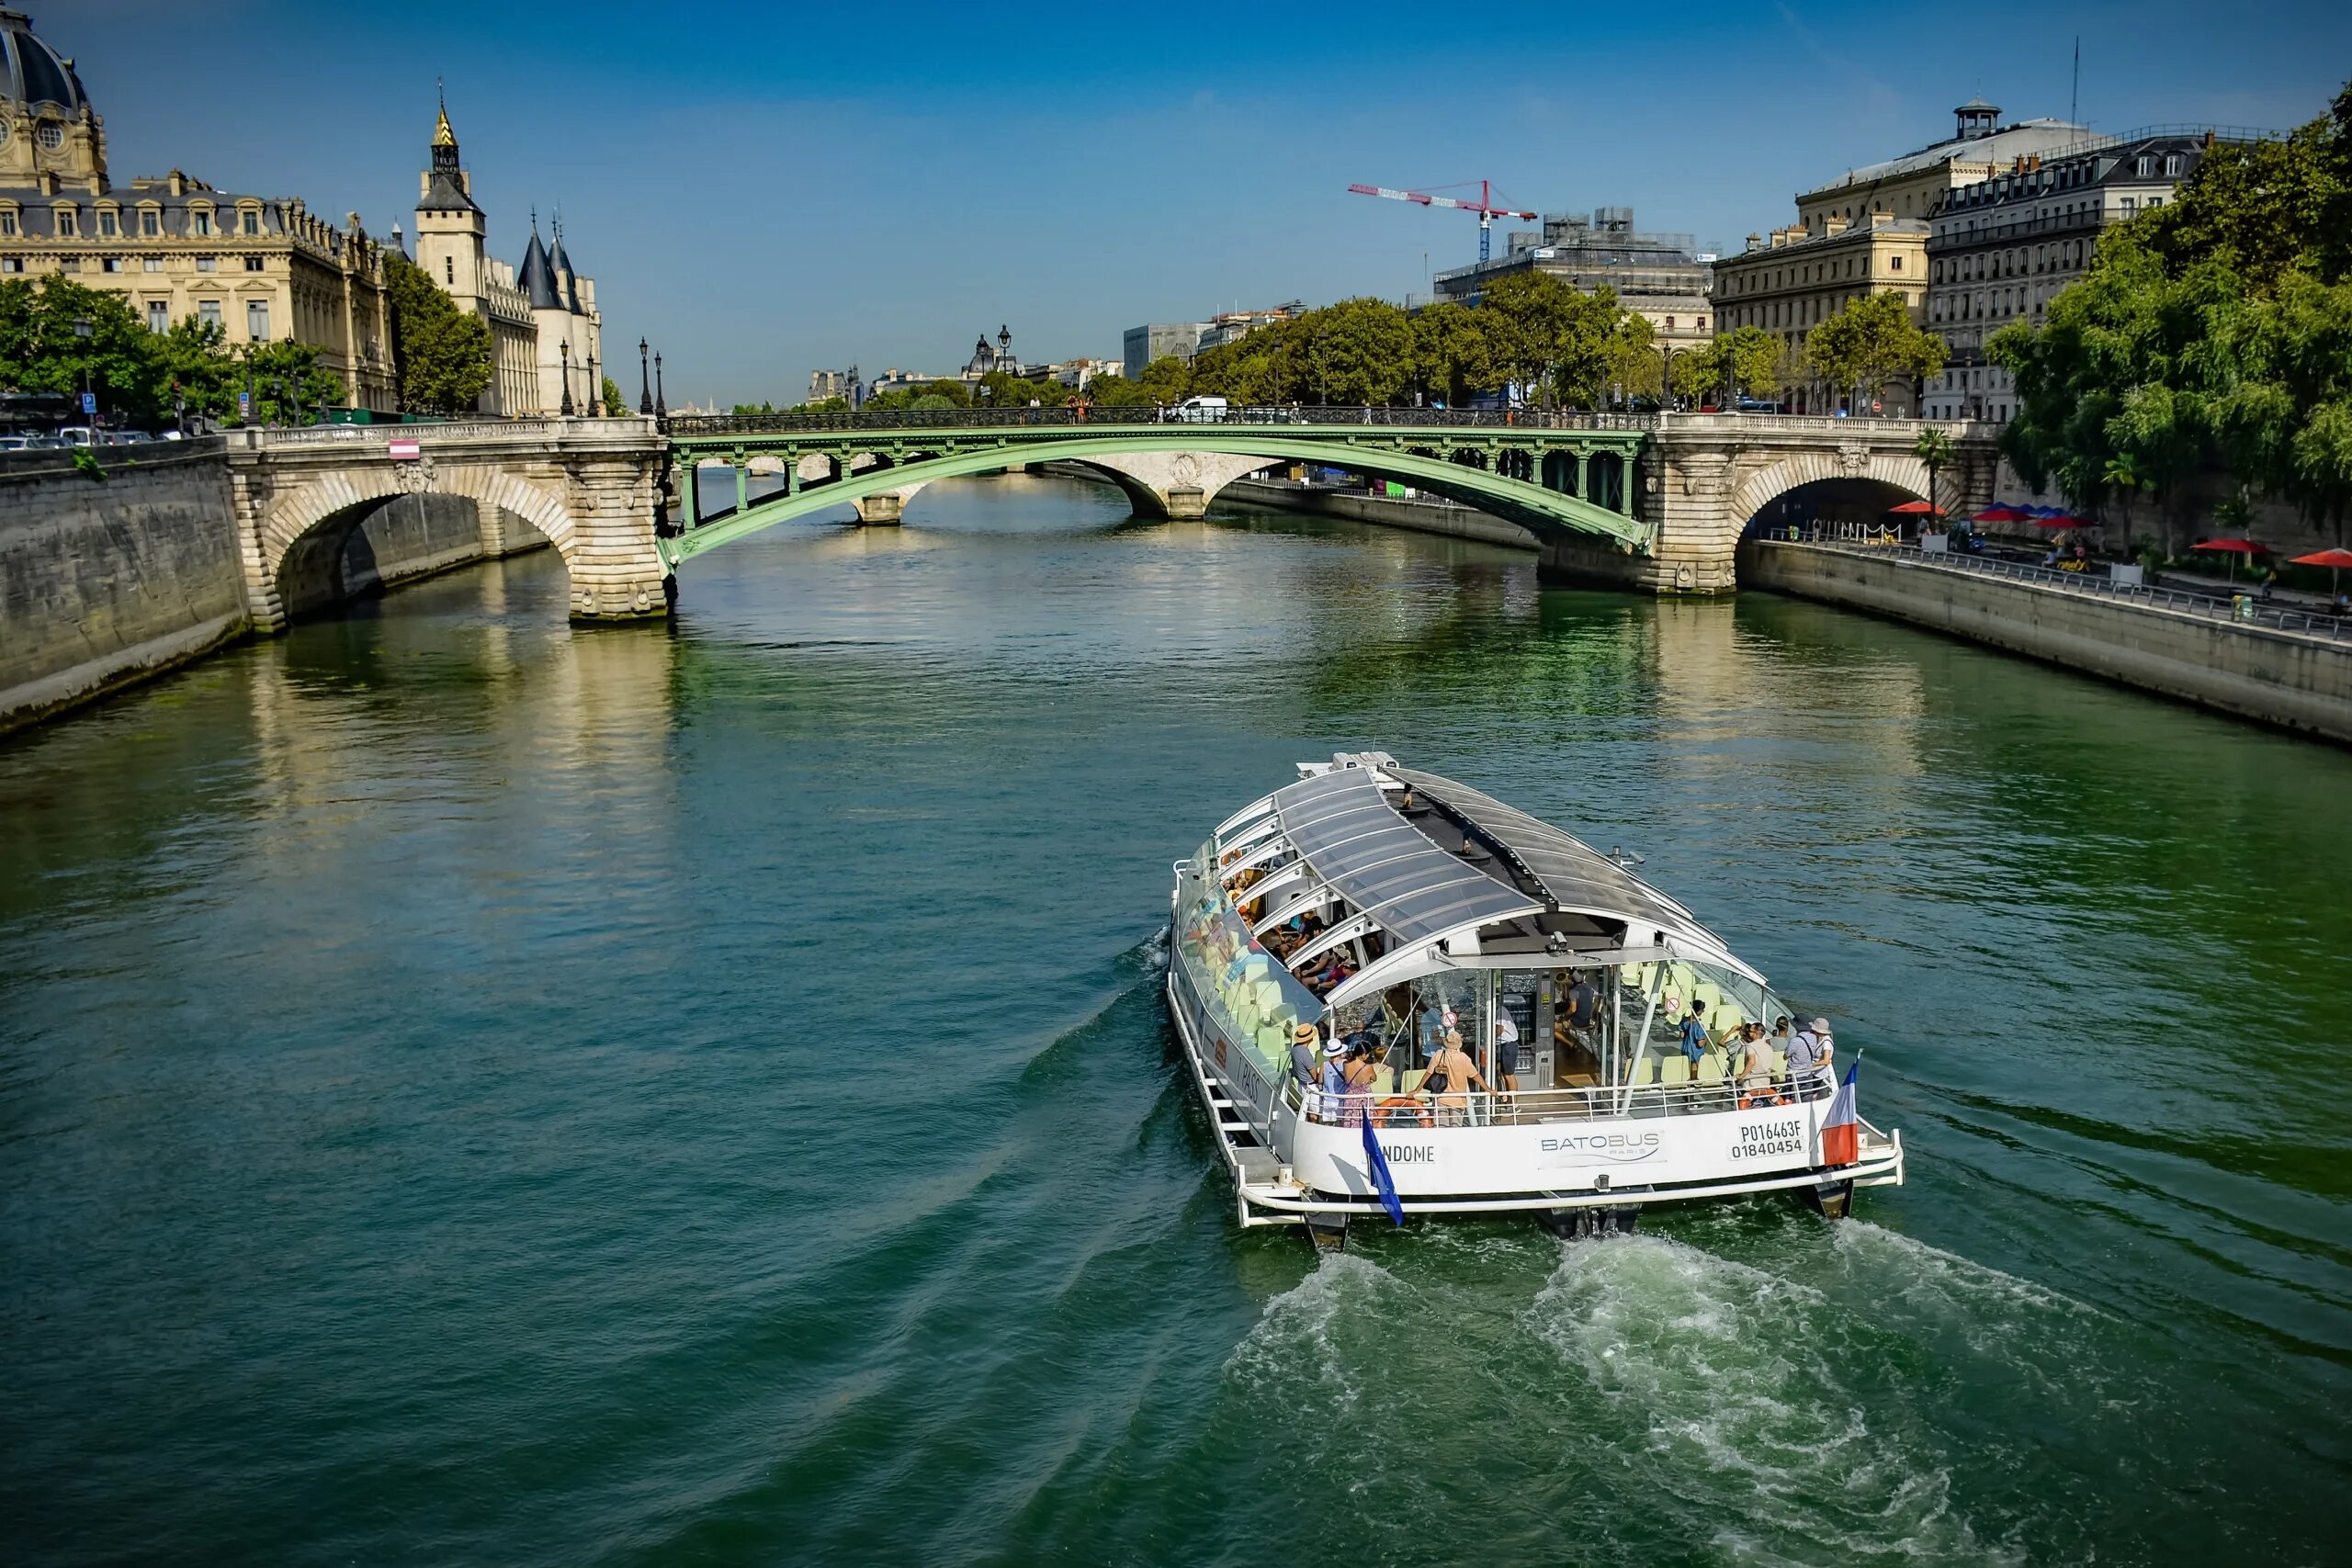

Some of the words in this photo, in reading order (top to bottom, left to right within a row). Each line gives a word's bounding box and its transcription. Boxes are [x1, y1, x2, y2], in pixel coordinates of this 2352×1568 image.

[85, 396, 92, 404] P
[1541, 1134, 1659, 1151] BATOBUS
[1732, 1140, 1802, 1158] 01840454
[1379, 1145, 1434, 1162] NDOME
